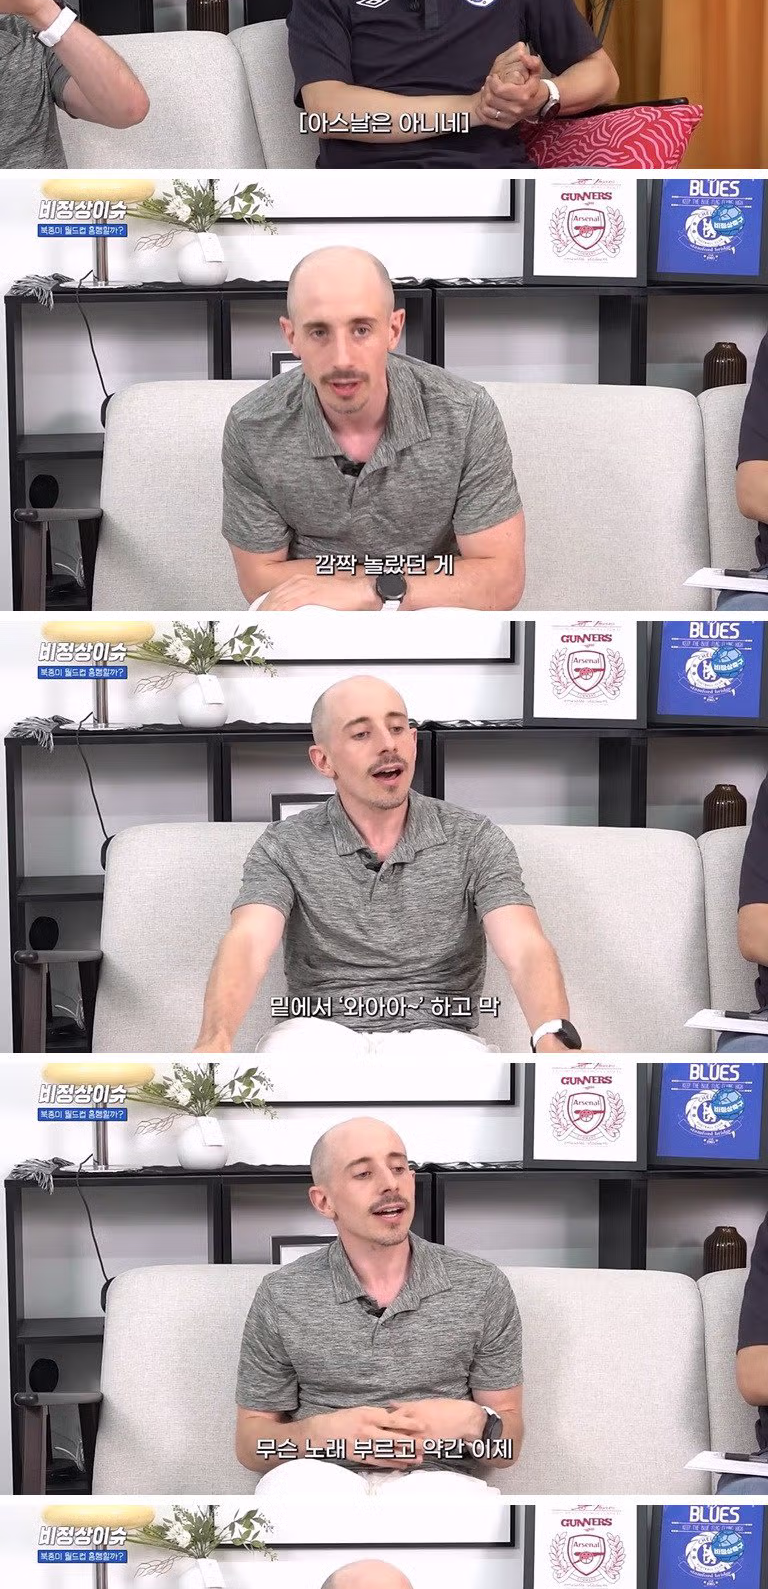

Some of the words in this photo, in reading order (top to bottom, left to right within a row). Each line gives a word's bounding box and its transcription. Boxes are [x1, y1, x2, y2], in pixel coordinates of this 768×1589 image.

[689, 180, 740, 197] BLUES
[560, 192, 613, 201] GUNNERS
[689, 1506, 740, 1523] BLUES
[560, 1518, 613, 1527] GUNNERS
